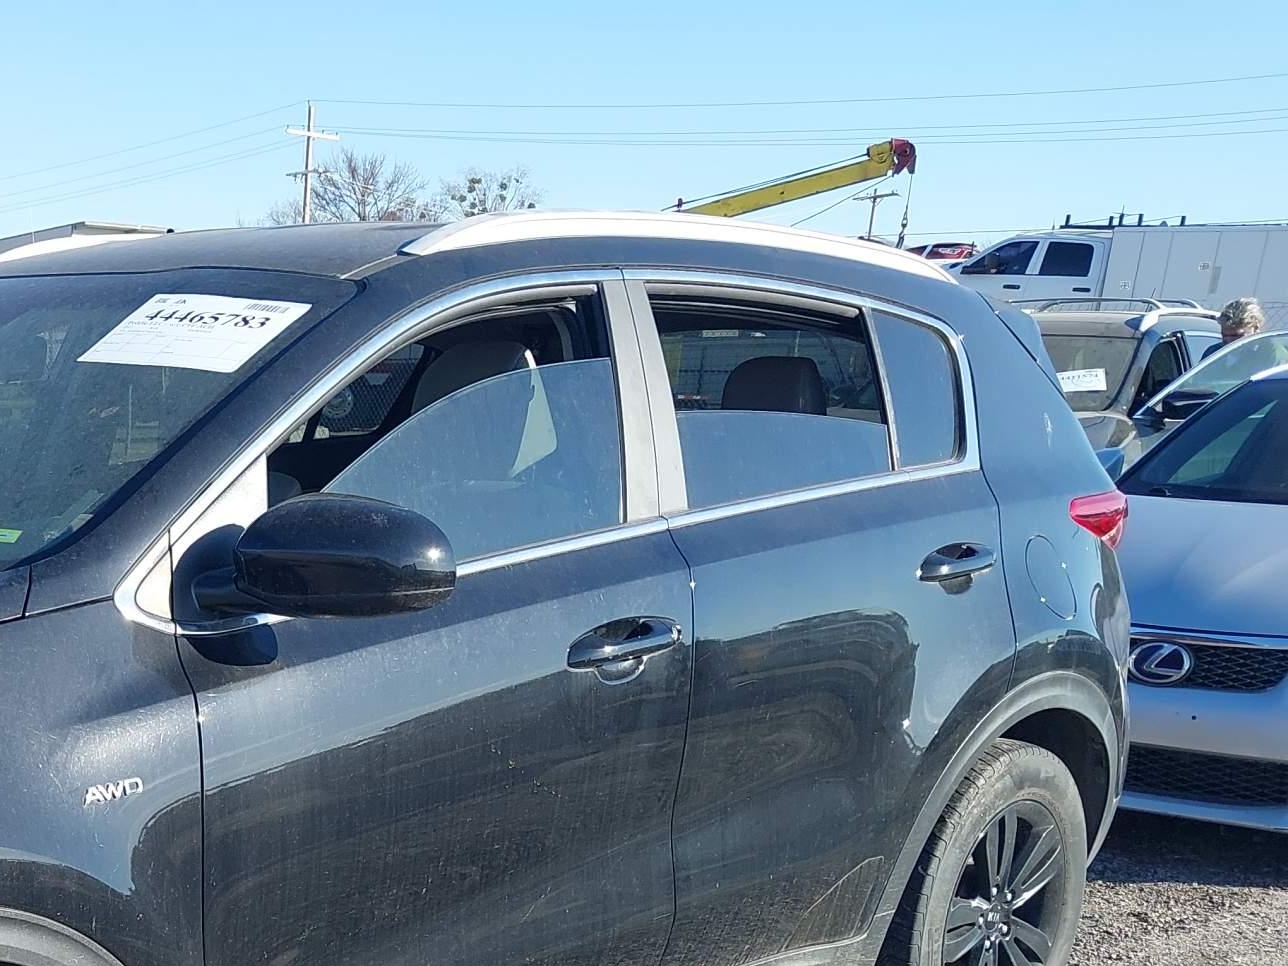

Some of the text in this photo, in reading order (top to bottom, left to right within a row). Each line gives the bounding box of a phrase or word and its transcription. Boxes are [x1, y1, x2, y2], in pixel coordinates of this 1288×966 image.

[145, 309, 272, 329] 44465783
[83, 777, 144, 808] AWD
[987, 911, 1000, 922] KIA
